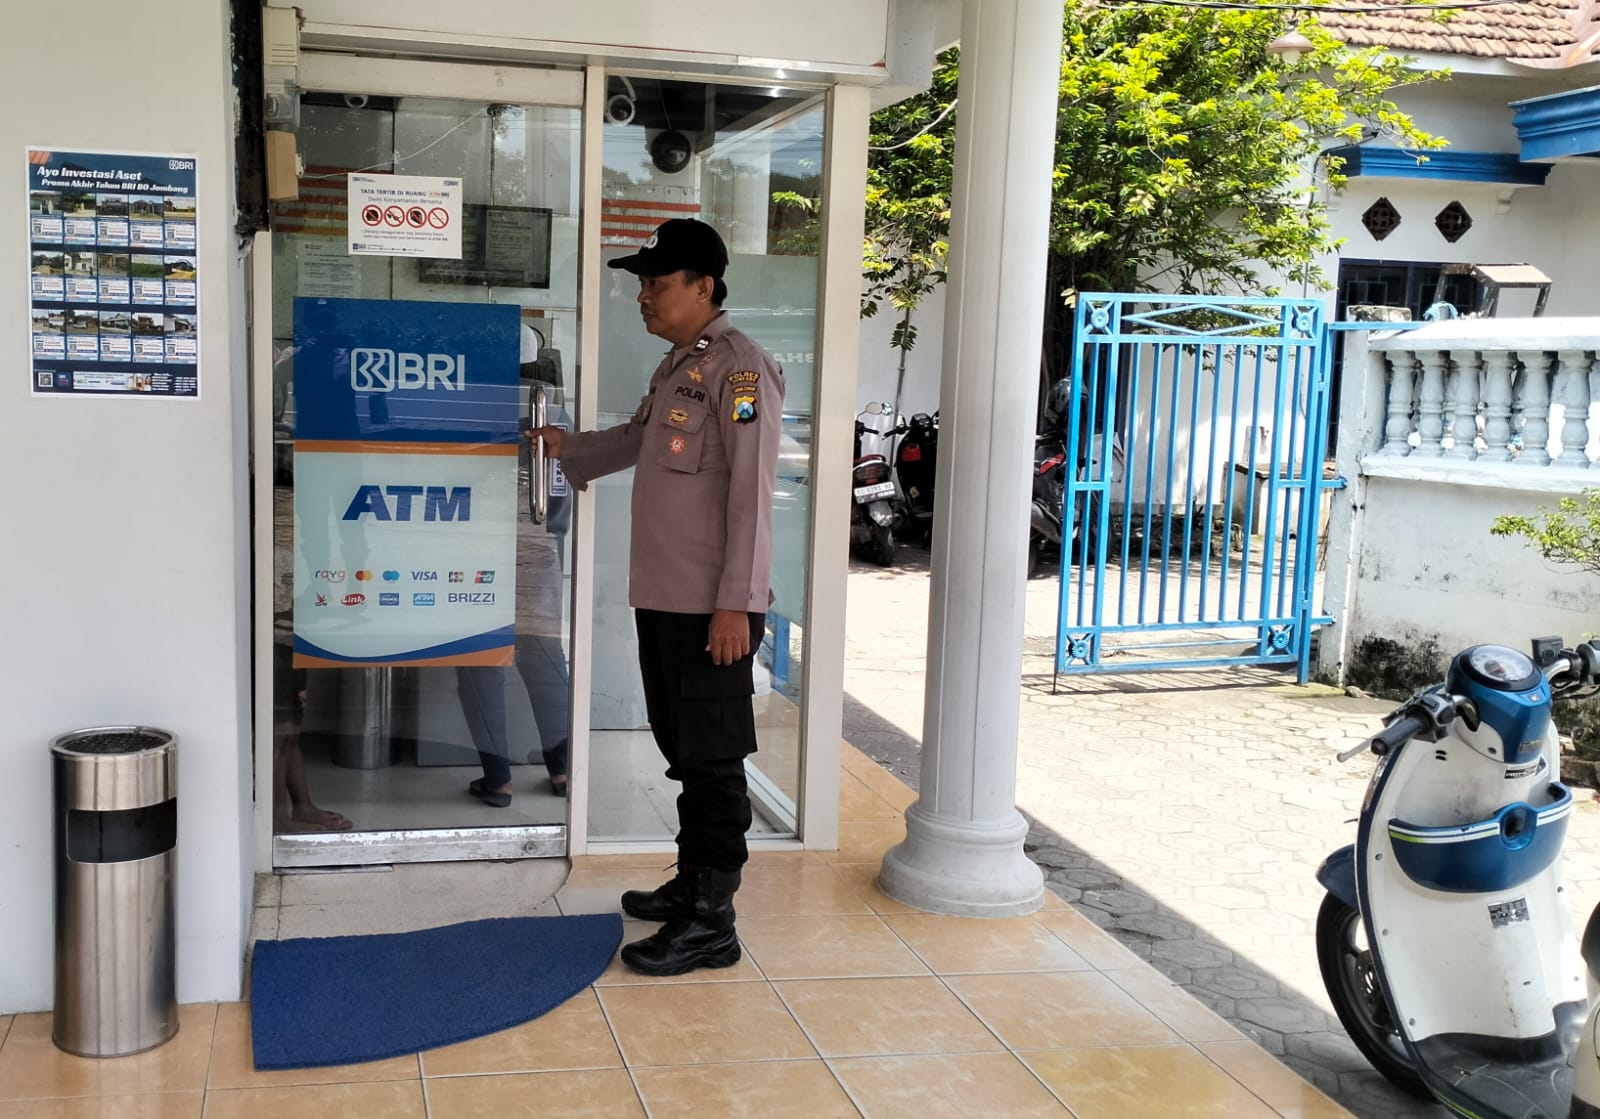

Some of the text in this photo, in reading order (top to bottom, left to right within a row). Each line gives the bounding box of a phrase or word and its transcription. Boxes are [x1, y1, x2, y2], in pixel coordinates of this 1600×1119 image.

[178, 161, 194, 170] BRI
[37, 166, 142, 181] Ayo Investasi Aset
[41, 179, 188, 194] Promo Akhir Tahun BRI BO Jombang
[398, 353, 465, 391] BRI
[675, 386, 705, 403] POLRI
[341, 485, 471, 521] ATM
[315, 570, 345, 581] raya
[411, 571, 438, 581] VISA
[341, 595, 363, 604] Link
[448, 593, 495, 602] BRIZZI
